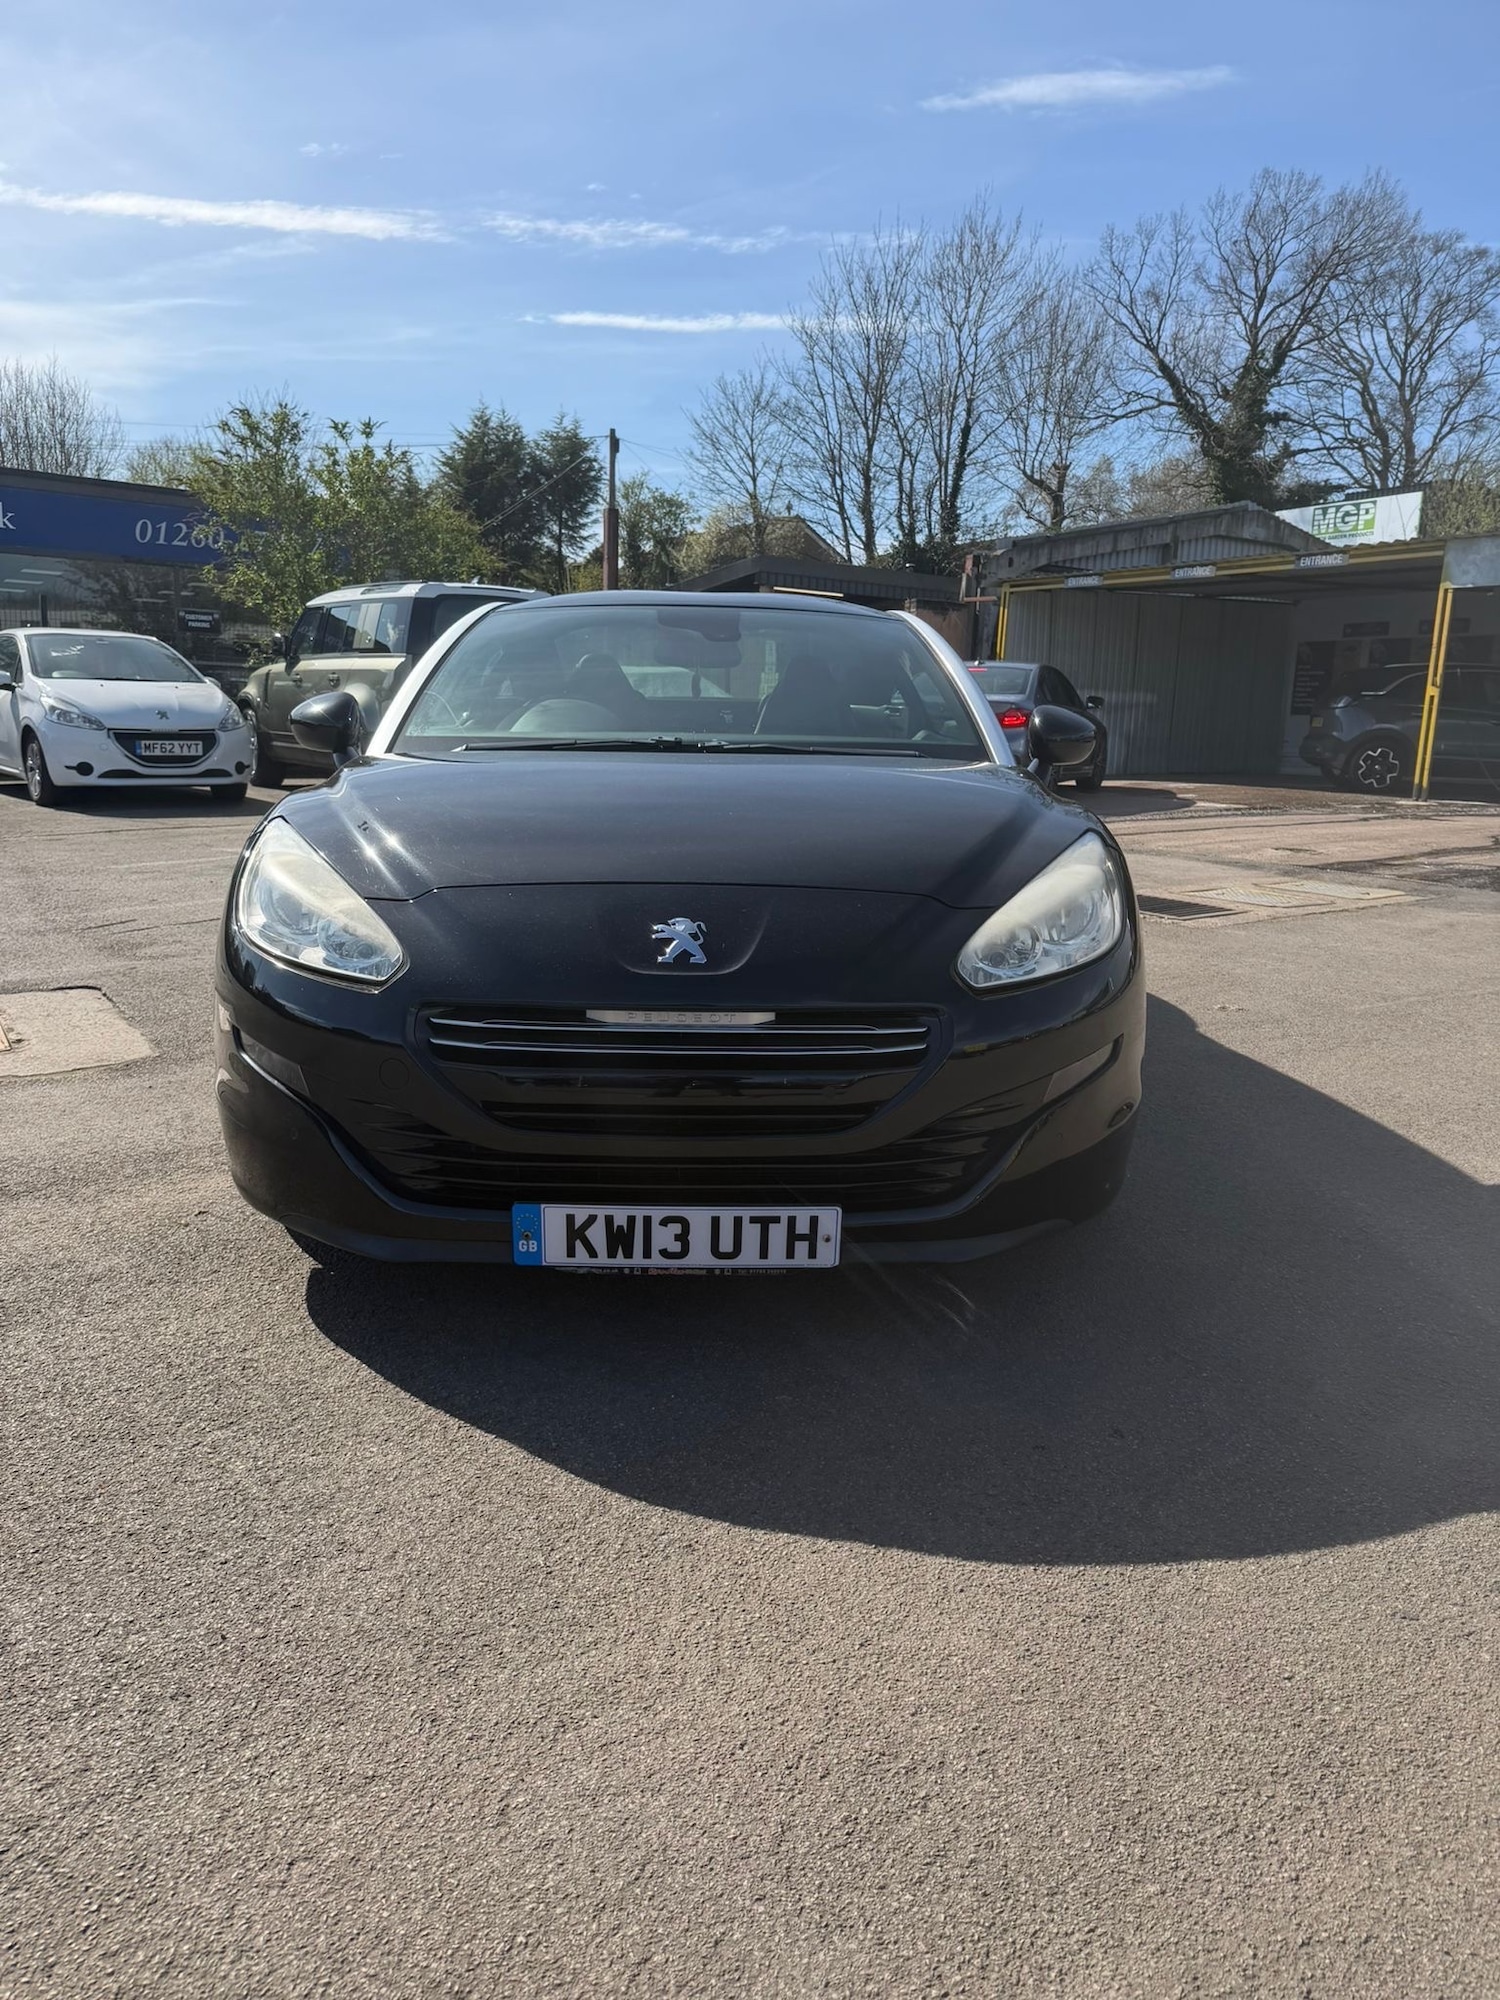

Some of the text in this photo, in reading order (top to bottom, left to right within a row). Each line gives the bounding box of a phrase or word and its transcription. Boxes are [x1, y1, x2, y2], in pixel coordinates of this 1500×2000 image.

[1312, 502, 1375, 535] MGP
[1300, 553, 1343, 567] ENTRANCE
[1174, 566, 1211, 578] ENTRANCE
[1067, 576, 1099, 586] ENTRANCE
[143, 742, 200, 753] MF62 YYT
[625, 1012, 736, 1023] PEUGEOT
[565, 1213, 819, 1260] KW13 UTH
[518, 1240, 537, 1252] GB
